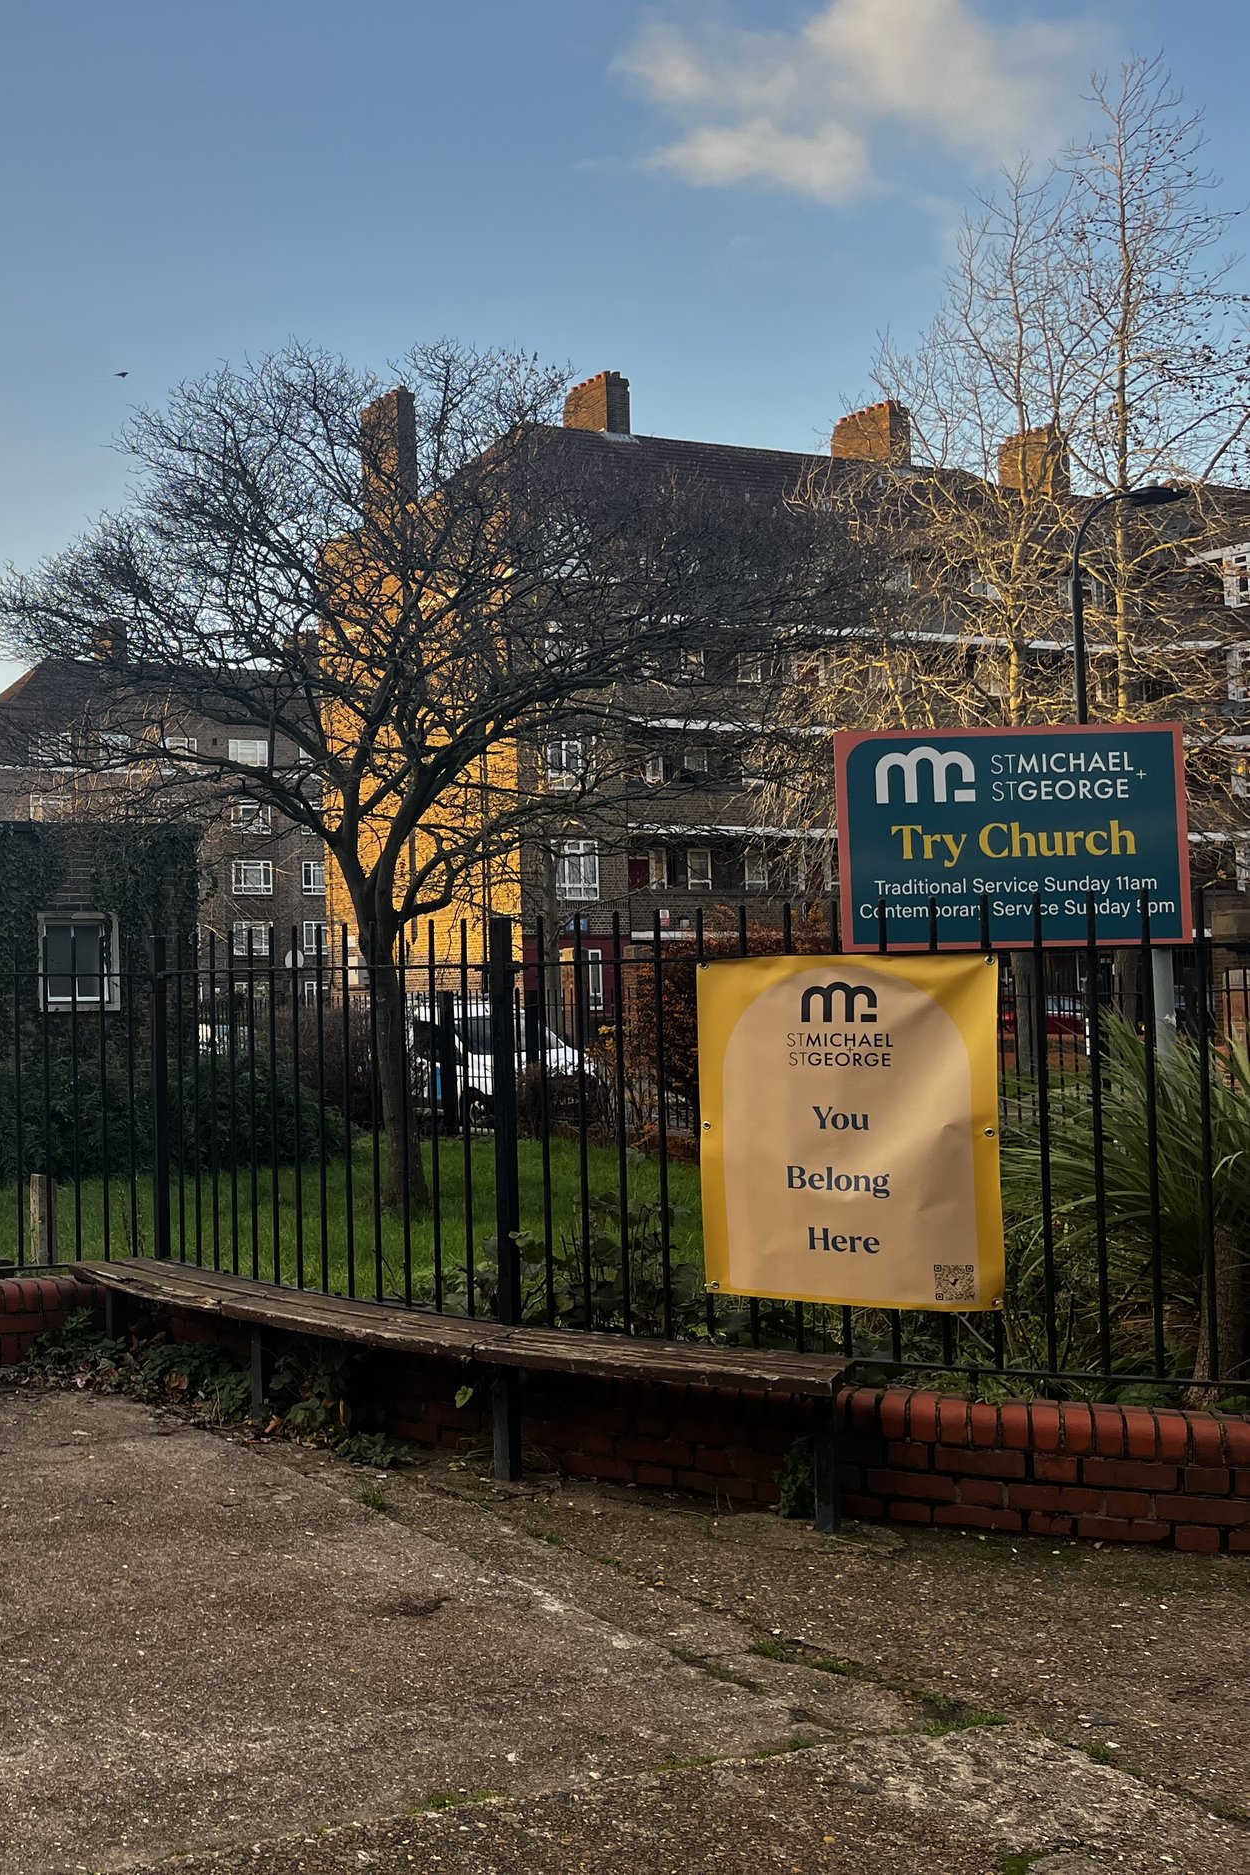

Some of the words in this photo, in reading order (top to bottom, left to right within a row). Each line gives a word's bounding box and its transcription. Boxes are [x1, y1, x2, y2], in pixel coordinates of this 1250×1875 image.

[891, 824, 967, 868] Try
[978, 819, 1136, 858] Church
[874, 878, 967, 895] Traditional
[972, 876, 1039, 894] Service
[1044, 875, 1110, 894] Sunday
[1116, 876, 1158, 890] 11am
[993, 900, 1059, 916] Servce
[812, 1106, 869, 1131] You
[787, 1166, 890, 1199] Belong
[808, 1227, 880, 1254] Here
